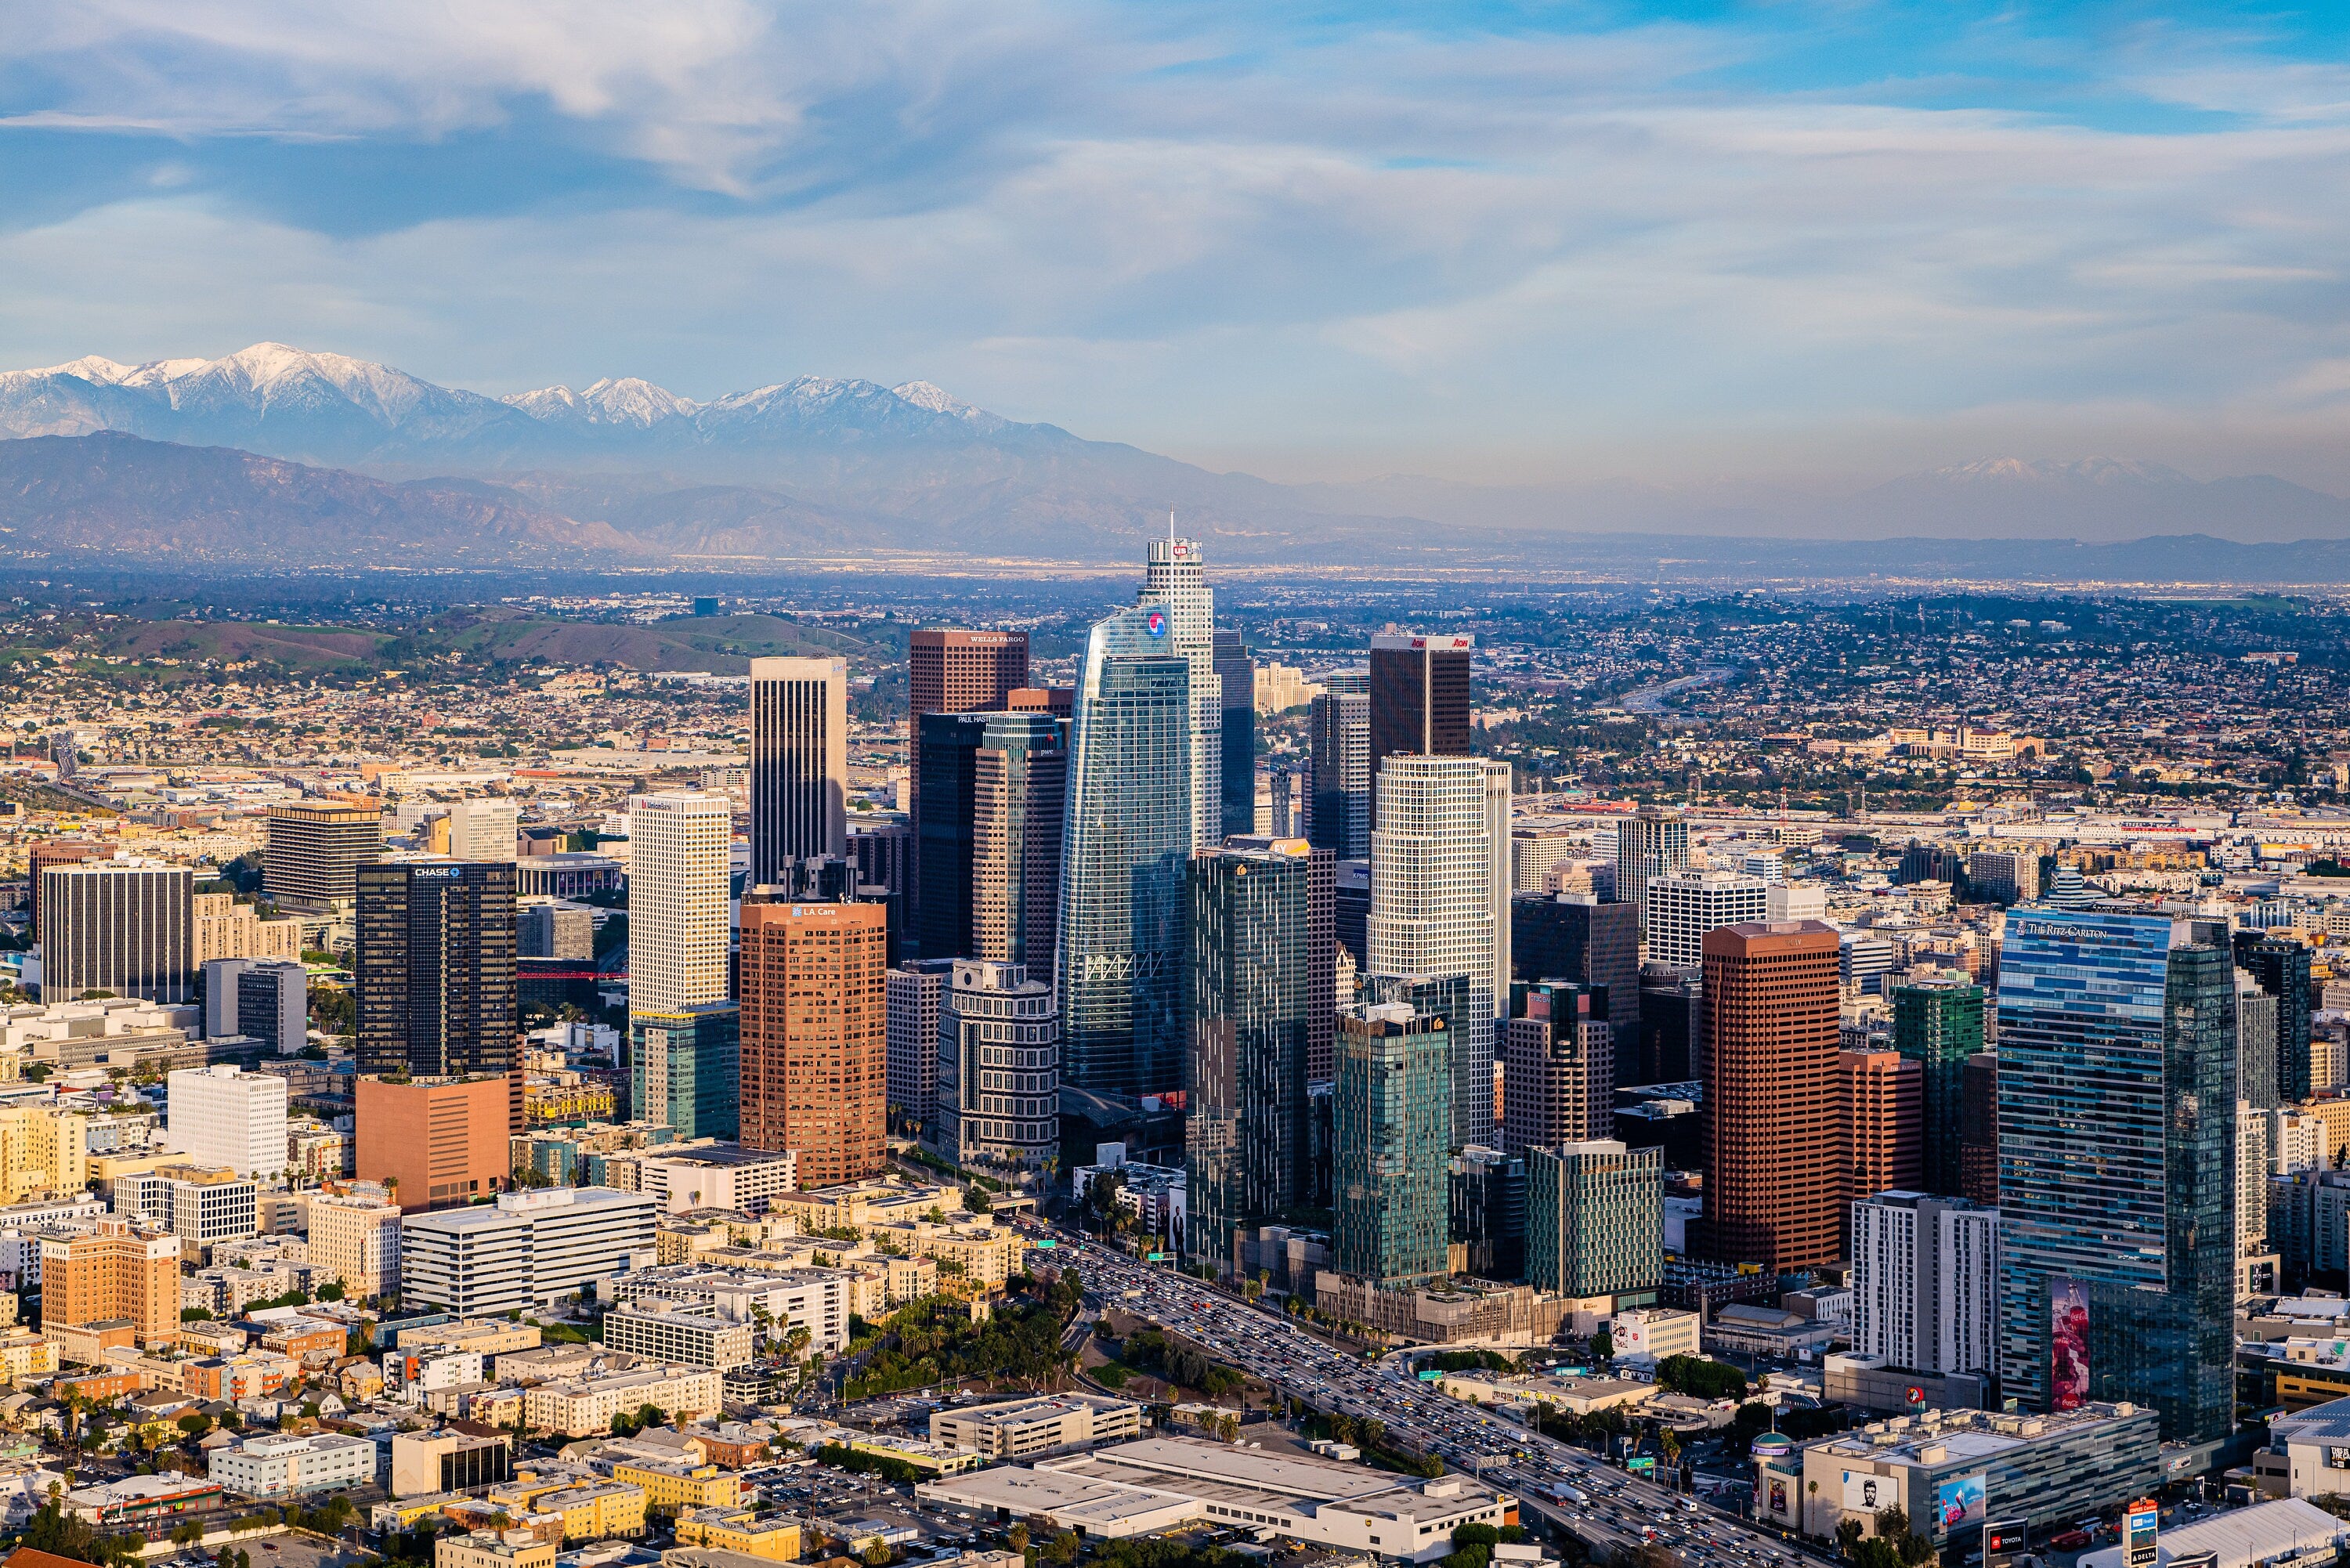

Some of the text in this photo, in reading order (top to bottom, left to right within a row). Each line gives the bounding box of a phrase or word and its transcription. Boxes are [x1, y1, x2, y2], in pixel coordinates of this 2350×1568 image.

[1274, 844, 1287, 854] EY
[414, 868, 450, 876] CHASE
[1672, 881, 1704, 890] WILSHIRE
[2029, 923, 2045, 934] THE
[2063, 1399, 2078, 1407] Coca-Cola
[2138, 1552, 2156, 1562] DELTA
